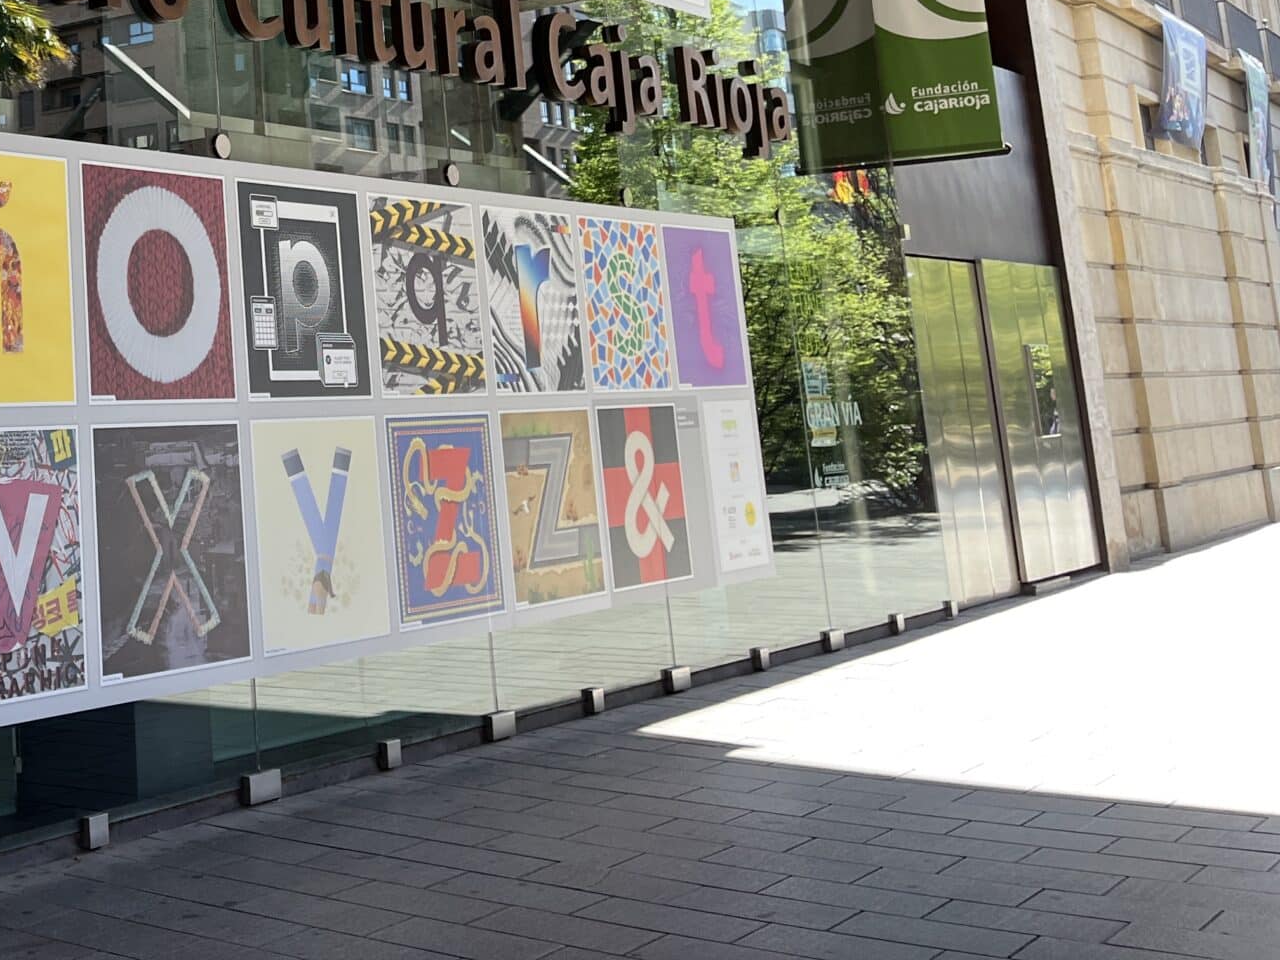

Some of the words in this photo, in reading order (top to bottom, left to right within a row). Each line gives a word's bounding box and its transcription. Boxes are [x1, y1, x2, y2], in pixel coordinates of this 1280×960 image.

[536, 12, 664, 137] Caja
[674, 46, 792, 159] Rioja
[911, 80, 979, 97] Fundación
[278, 239, 331, 355] p
[406, 251, 449, 346] q
[689, 246, 725, 370] t
[841, 393, 863, 426] VÍA
[624, 430, 675, 559] &
